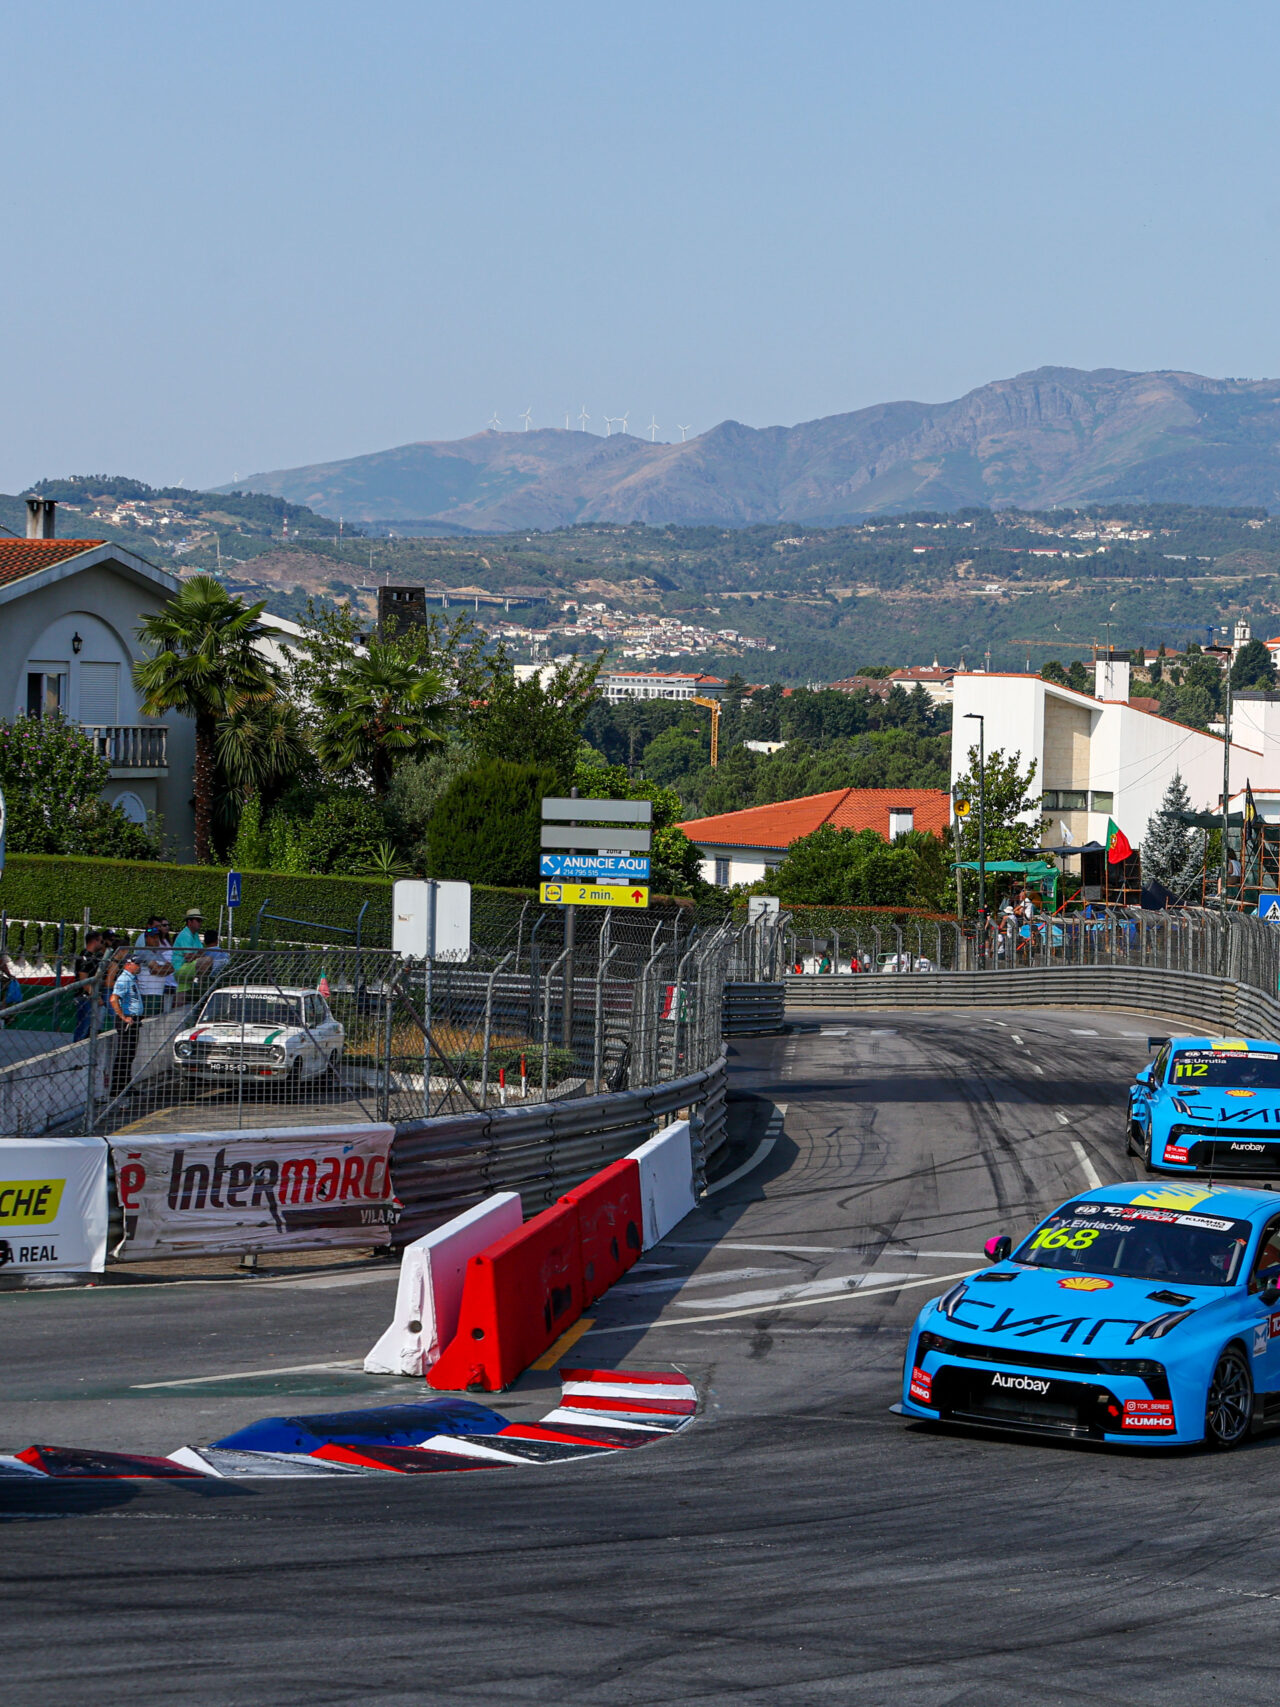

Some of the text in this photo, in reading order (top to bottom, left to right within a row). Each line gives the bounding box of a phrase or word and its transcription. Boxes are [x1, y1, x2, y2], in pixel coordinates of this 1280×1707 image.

[563, 857, 647, 870] ANUNCIE AQUI
[579, 888, 614, 900] 2 min.
[1175, 1063, 1209, 1077] 112
[1230, 1142, 1266, 1152] Aurobay
[361, 1209, 385, 1224] VILA
[1076, 1206, 1098, 1214] FIA
[1102, 1206, 1137, 1214] TCR
[1059, 1219, 1135, 1232] Y.Ehrlacher
[1139, 1215, 1174, 1223] TOUR
[1185, 1217, 1225, 1226] KUMHO
[1029, 1227, 1100, 1250] 168
[19, 1245, 58, 1263] REAL
[991, 1372, 1050, 1394] Aurobay
[1125, 1417, 1172, 1426] KUMHO
